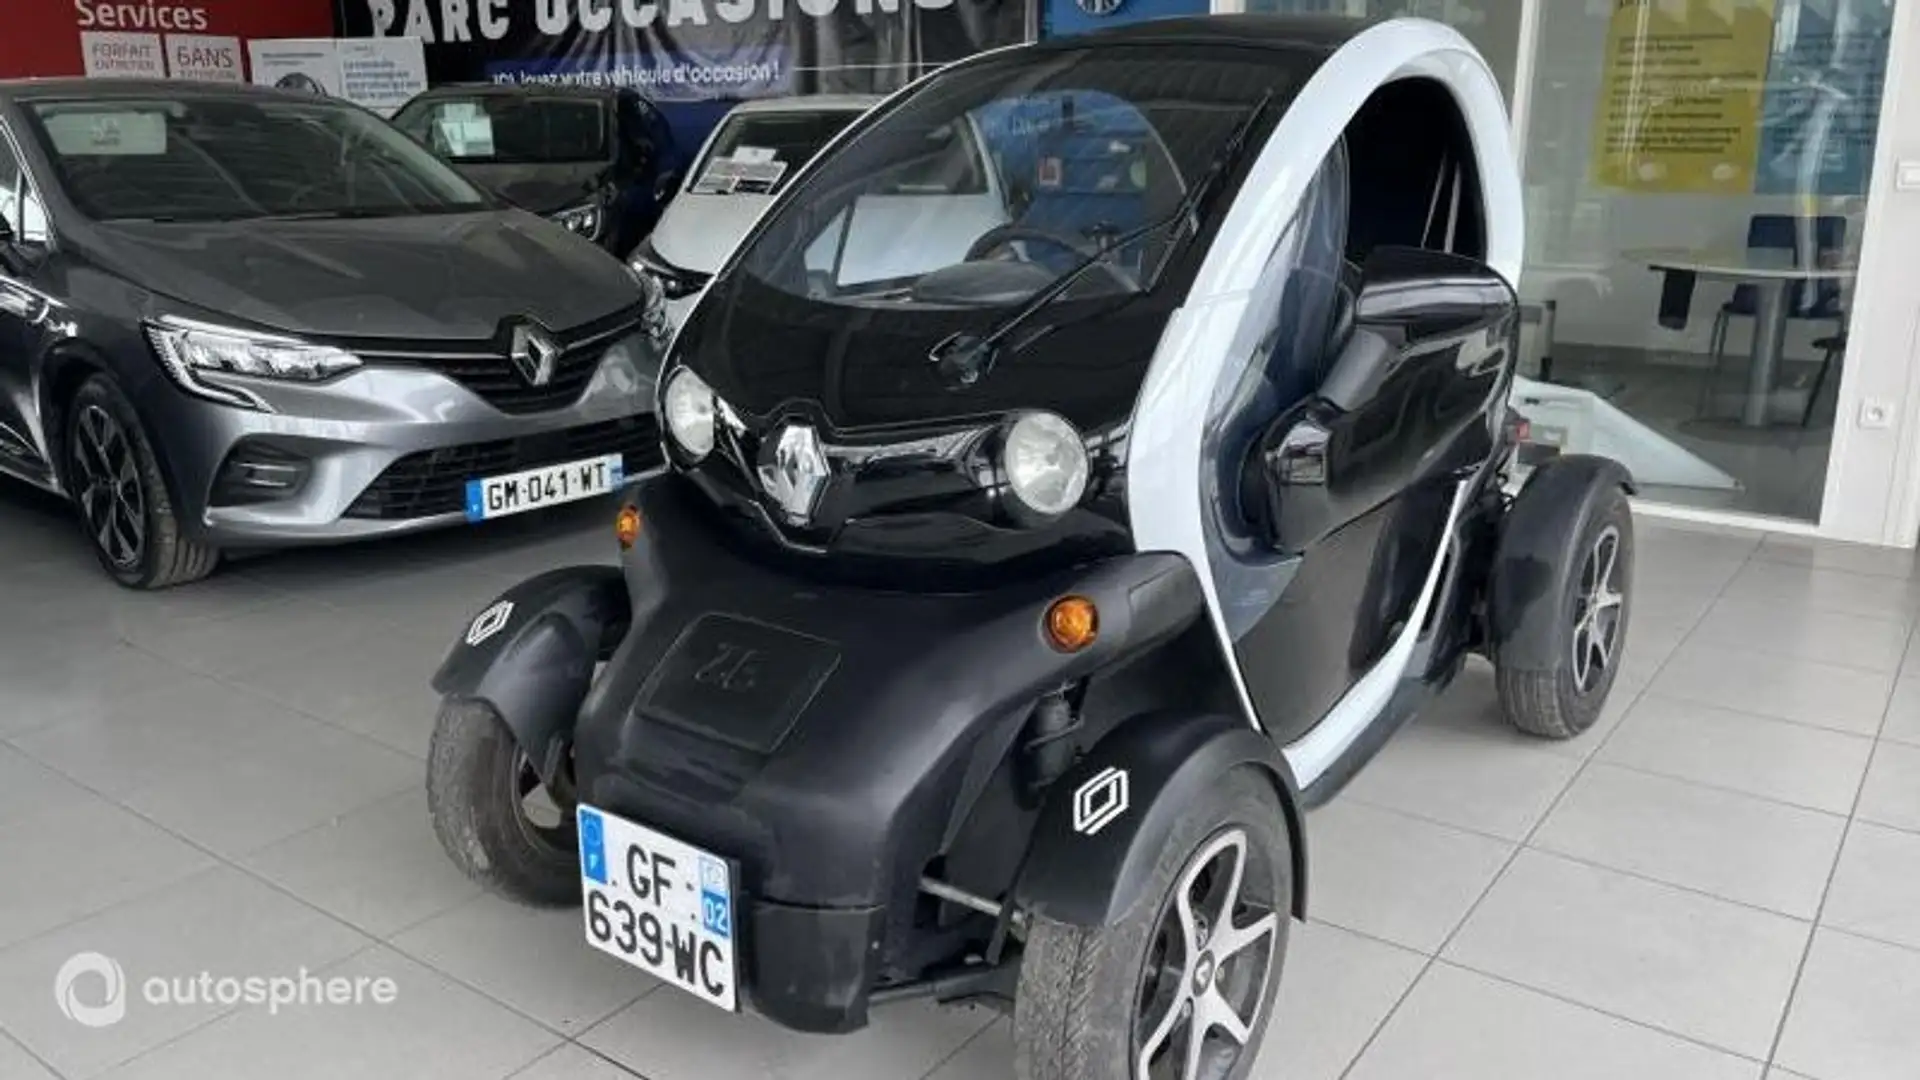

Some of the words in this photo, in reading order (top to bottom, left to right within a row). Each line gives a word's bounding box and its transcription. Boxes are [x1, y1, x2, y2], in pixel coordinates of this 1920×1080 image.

[75, 0, 208, 31] Services
[367, 0, 510, 43] PARC
[673, 61, 771, 83] d'occasion
[703, 898, 729, 933] 02
[588, 889, 724, 997] 639-WC
